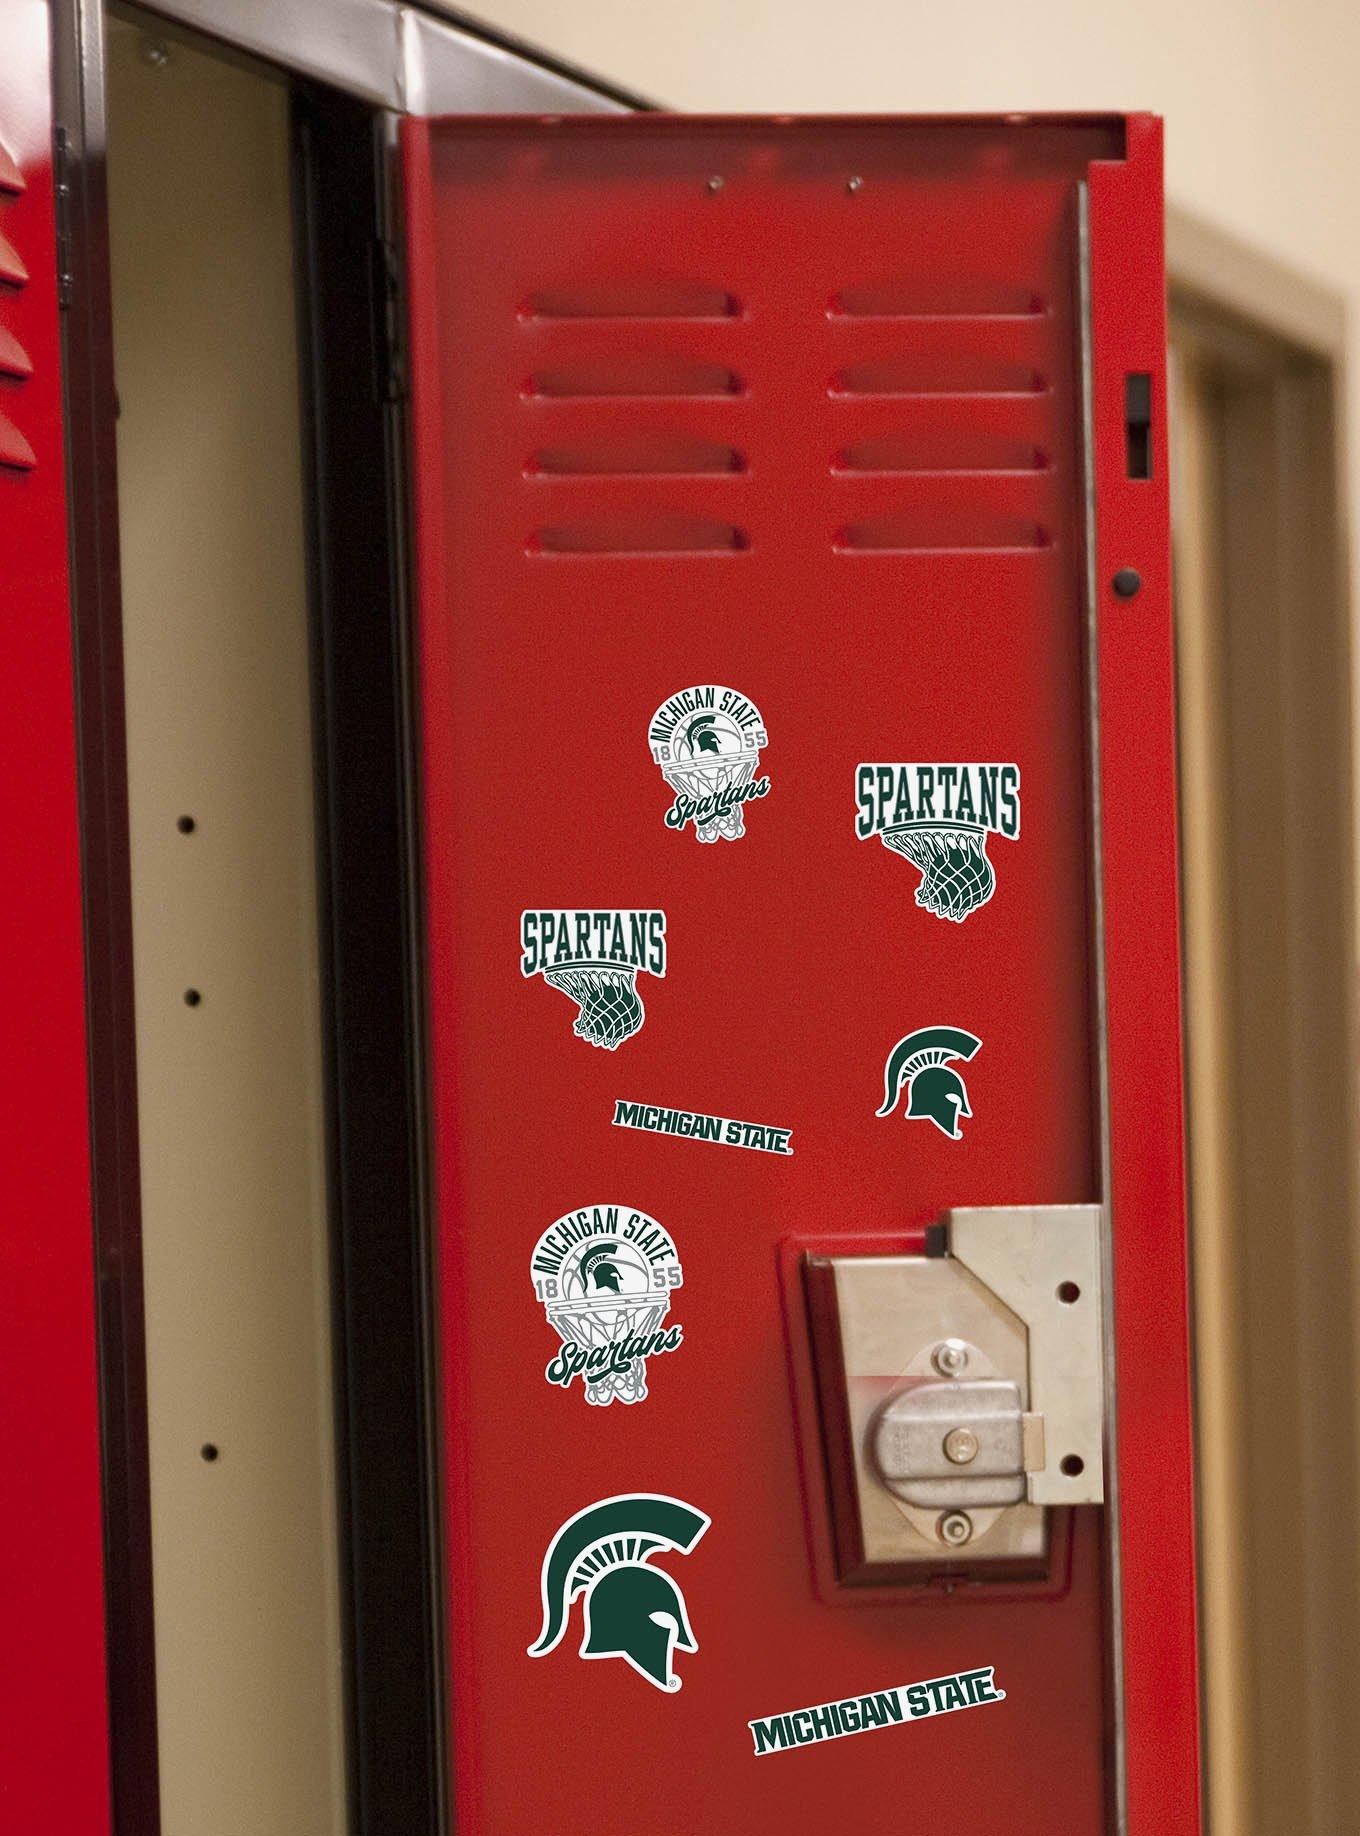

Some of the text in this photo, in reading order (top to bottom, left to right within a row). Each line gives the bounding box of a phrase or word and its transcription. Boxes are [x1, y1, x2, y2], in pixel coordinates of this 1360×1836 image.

[650, 687, 761, 743] MICHIGAN STATE
[653, 730, 767, 762] 18 55
[666, 778, 769, 828] Spartans
[858, 766, 1017, 836] SPARTANS
[523, 912, 664, 974] SPARTANS
[613, 1101, 792, 1153] MICHIGAN STATE
[533, 1207, 675, 1276] MICHIGAN STATE
[536, 1266, 681, 1299] 18 55
[547, 1327, 681, 1386] Spartans
[750, 1668, 999, 1753] MICHIGAN STATE
